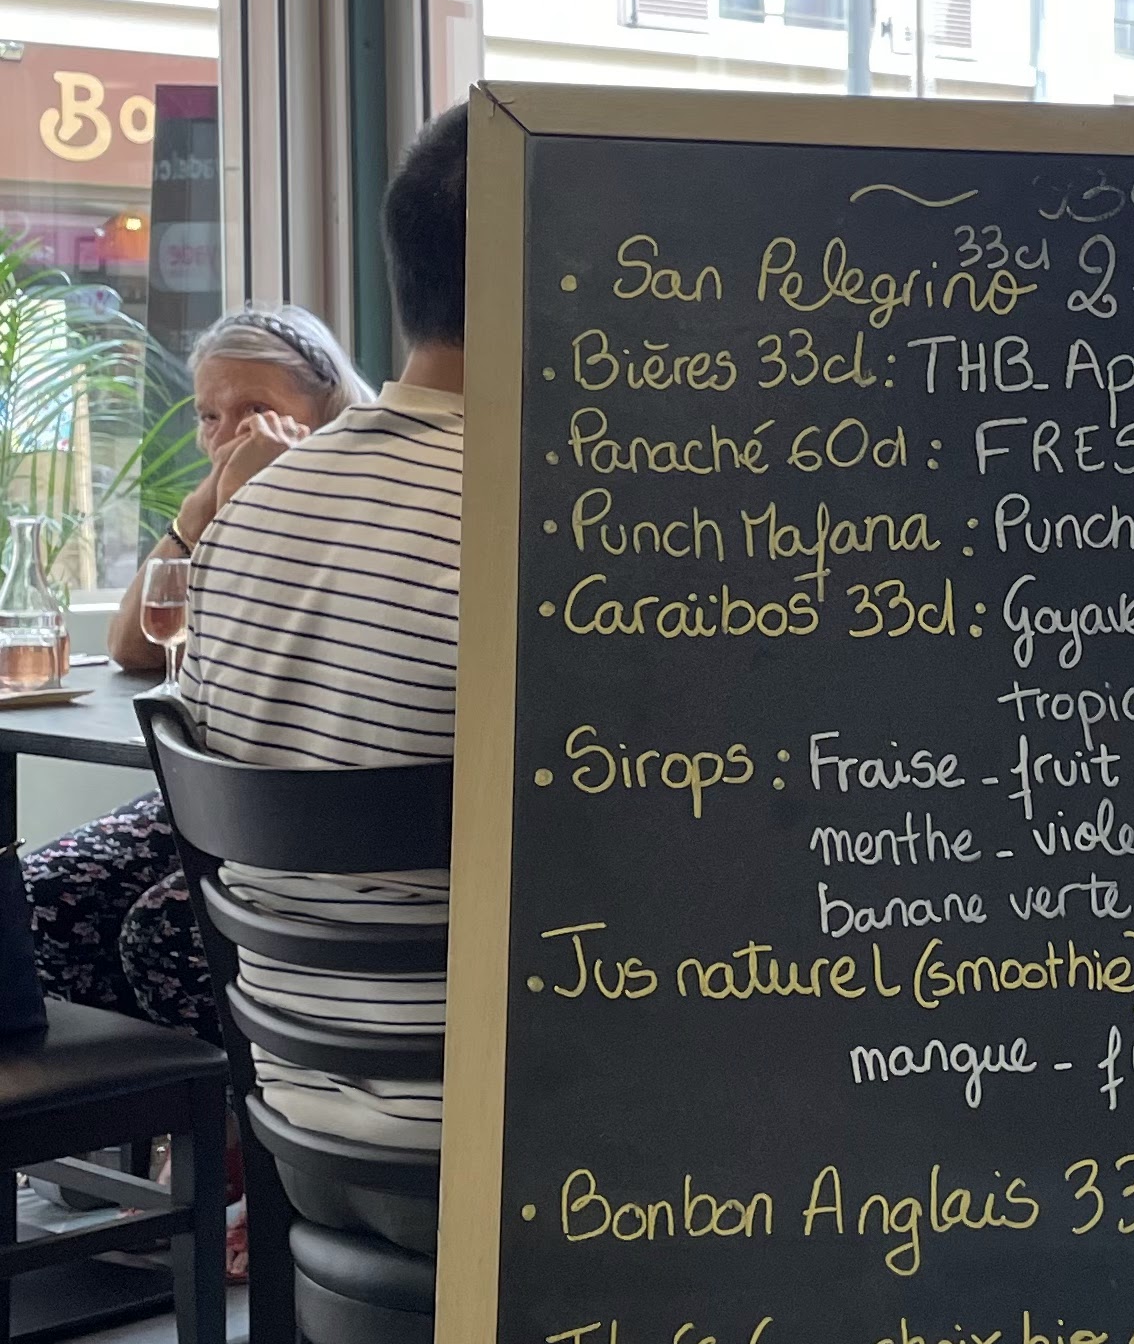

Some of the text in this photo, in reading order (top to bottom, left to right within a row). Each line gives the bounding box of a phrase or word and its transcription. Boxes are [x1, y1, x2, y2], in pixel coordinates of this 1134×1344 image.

[613, 234, 722, 302] San
[757, 231, 1038, 329] Pelegrino
[567, 407, 776, 475] Panaché
[571, 487, 725, 562] Punch
[565, 724, 754, 819] Sirops
[809, 730, 966, 793] Fraise
[1007, 734, 1121, 821] fruit
[809, 811, 982, 866] menthe
[817, 881, 988, 939] banane
[1009, 871, 1132, 921] verte
[540, 921, 658, 1000] Jus
[676, 940, 902, 1000] naturel
[849, 1037, 1038, 1109] mangue
[561, 1168, 773, 1242] Bonbon
[802, 1164, 1040, 1277] Anglais
